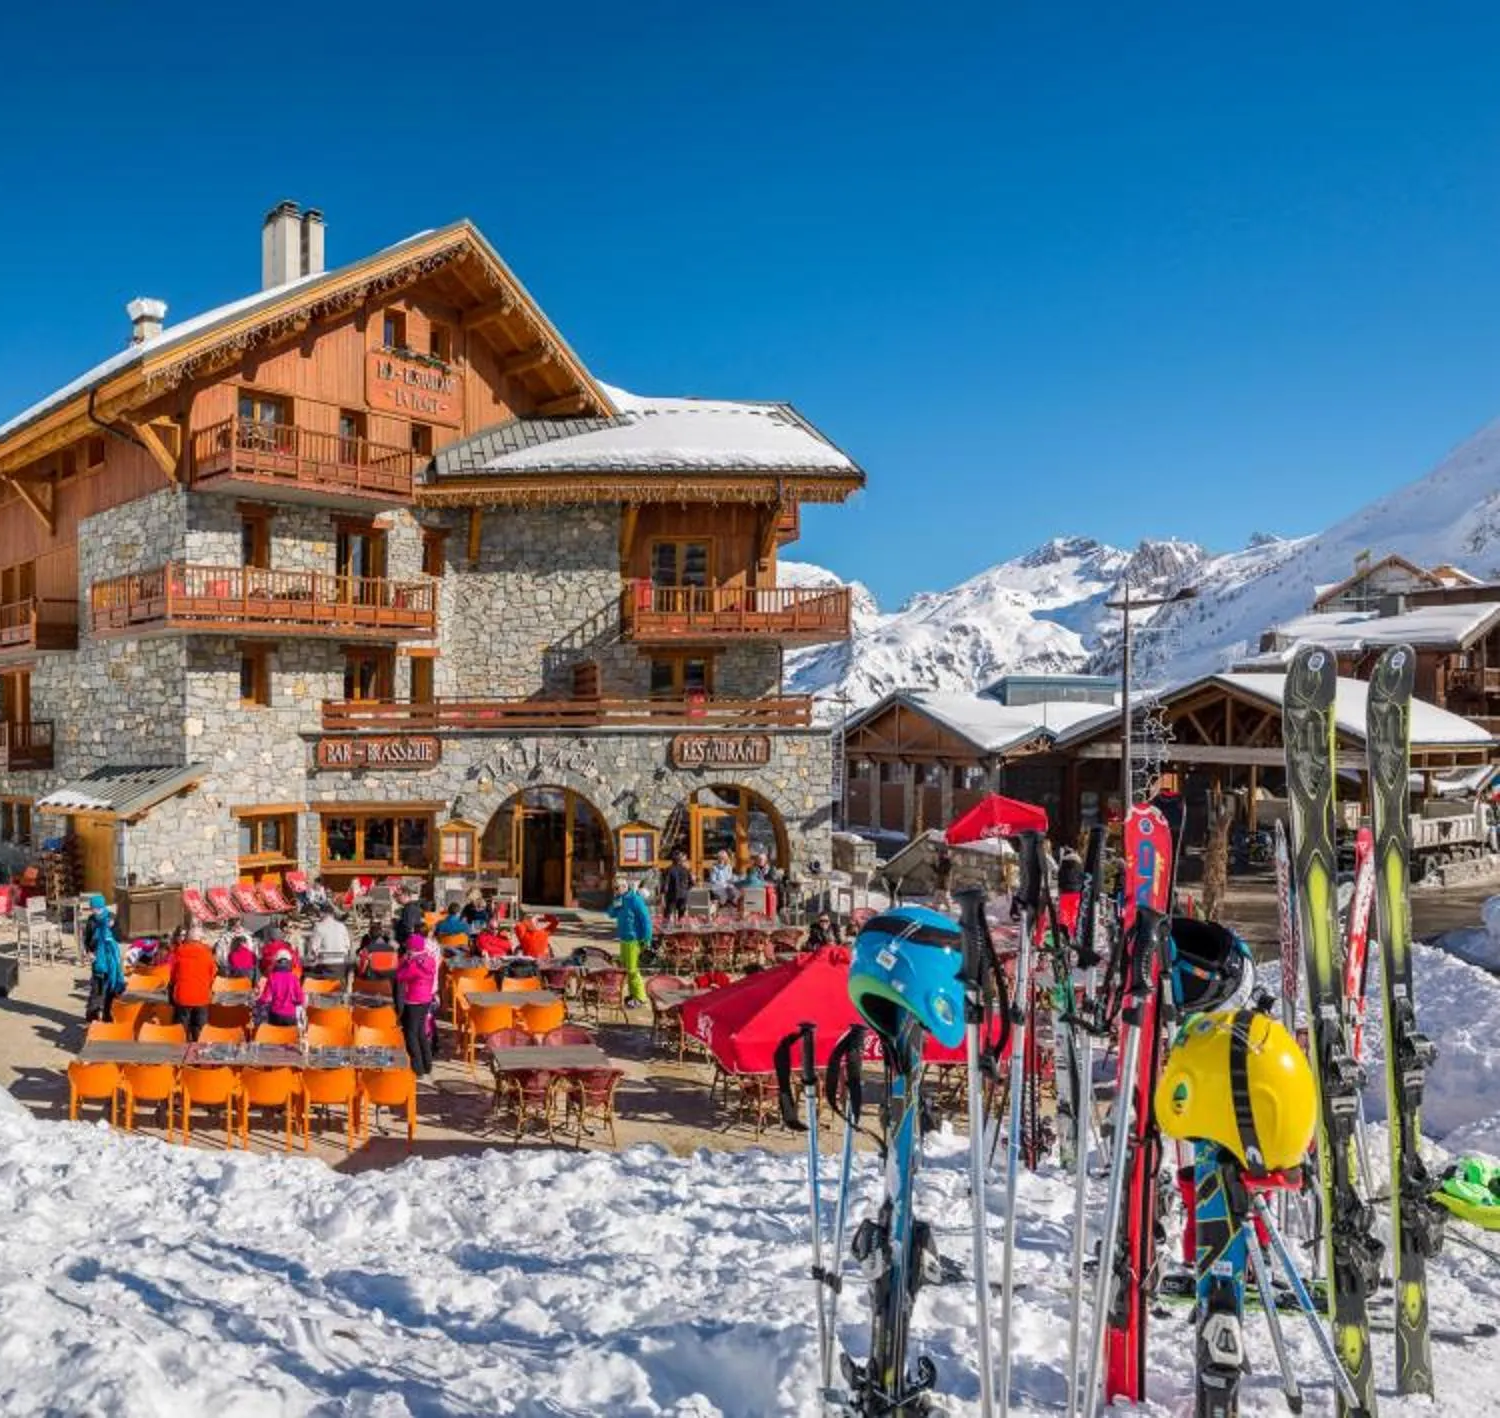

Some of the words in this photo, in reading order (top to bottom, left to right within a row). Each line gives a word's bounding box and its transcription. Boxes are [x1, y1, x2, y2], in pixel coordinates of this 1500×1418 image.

[326, 742, 352, 763] BAR
[366, 741, 434, 762] BRASSERIE
[682, 738, 768, 762] RESTAURANT
